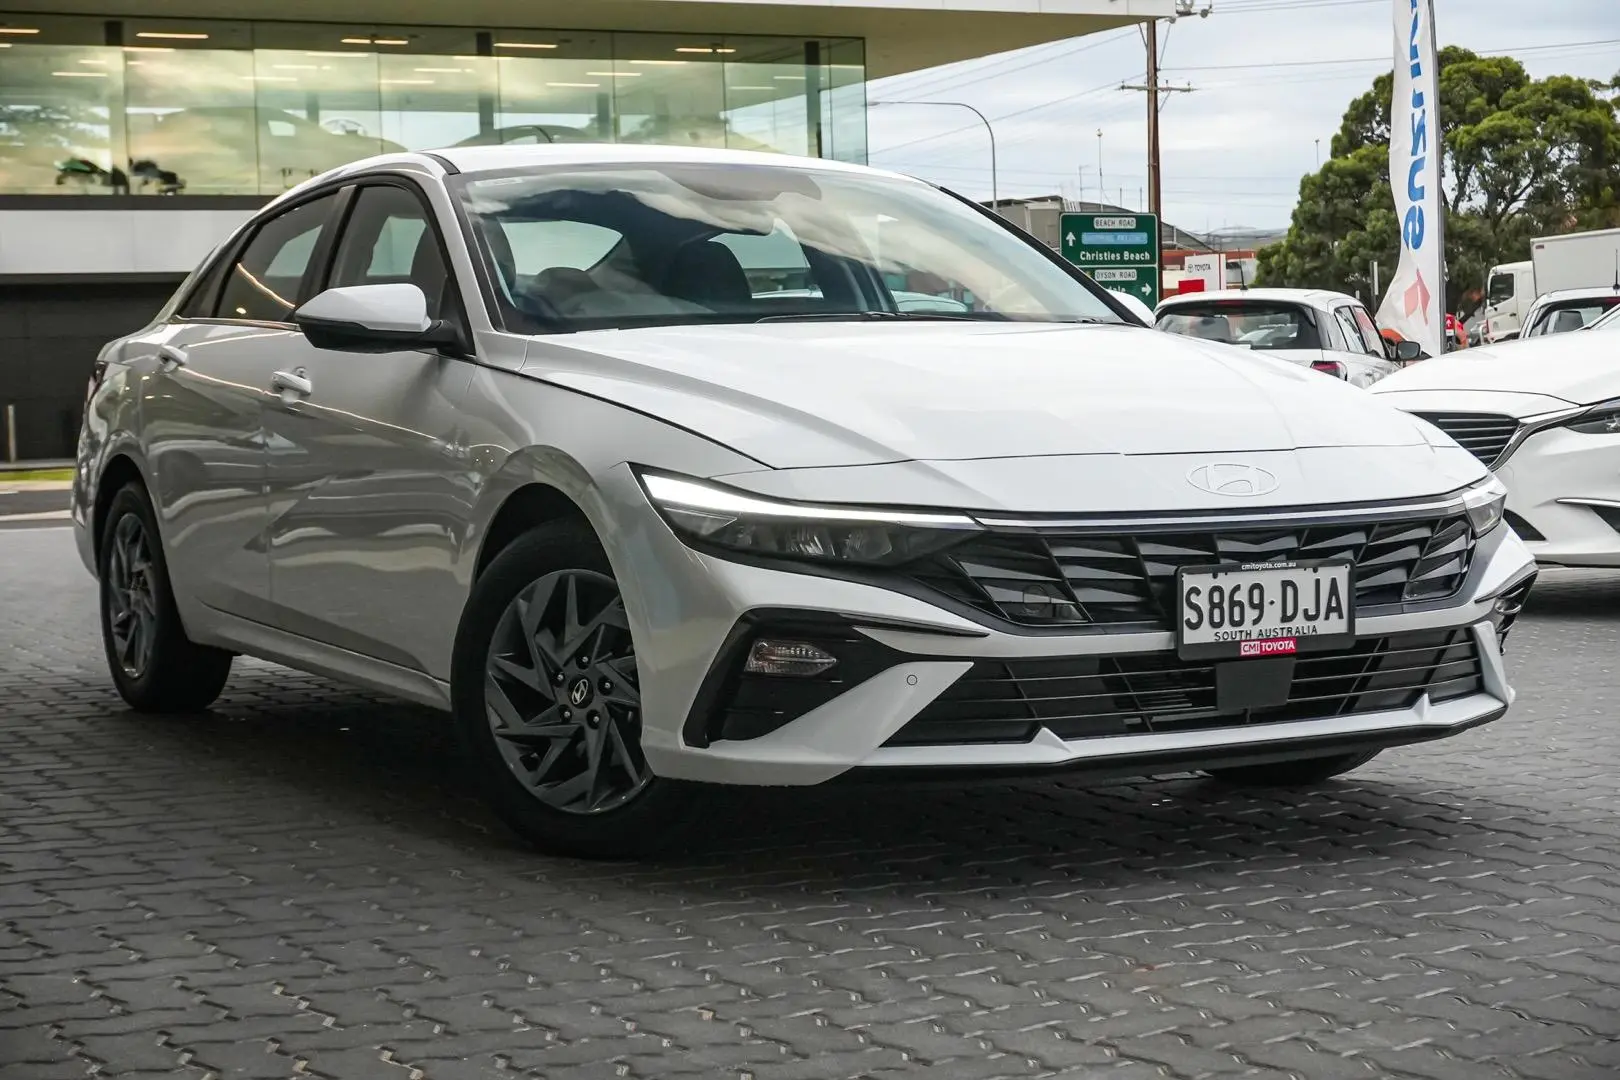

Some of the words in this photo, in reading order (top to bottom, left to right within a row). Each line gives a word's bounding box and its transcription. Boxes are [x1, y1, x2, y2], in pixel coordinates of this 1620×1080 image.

[1096, 219, 1116, 227] BEACH
[1119, 219, 1135, 227] ROAD
[1079, 250, 1121, 261] Christies
[1123, 250, 1151, 261] Beach
[1194, 263, 1212, 272] TOYOTA
[1096, 271, 1116, 280] DYSON
[1119, 271, 1136, 279] ROAD
[1241, 561, 1297, 571] cmitoyota.com.au
[1214, 629, 1252, 642] SOUTH
[1257, 624, 1319, 639] AUSTRALIA
[1260, 640, 1296, 652] TOYOTA
